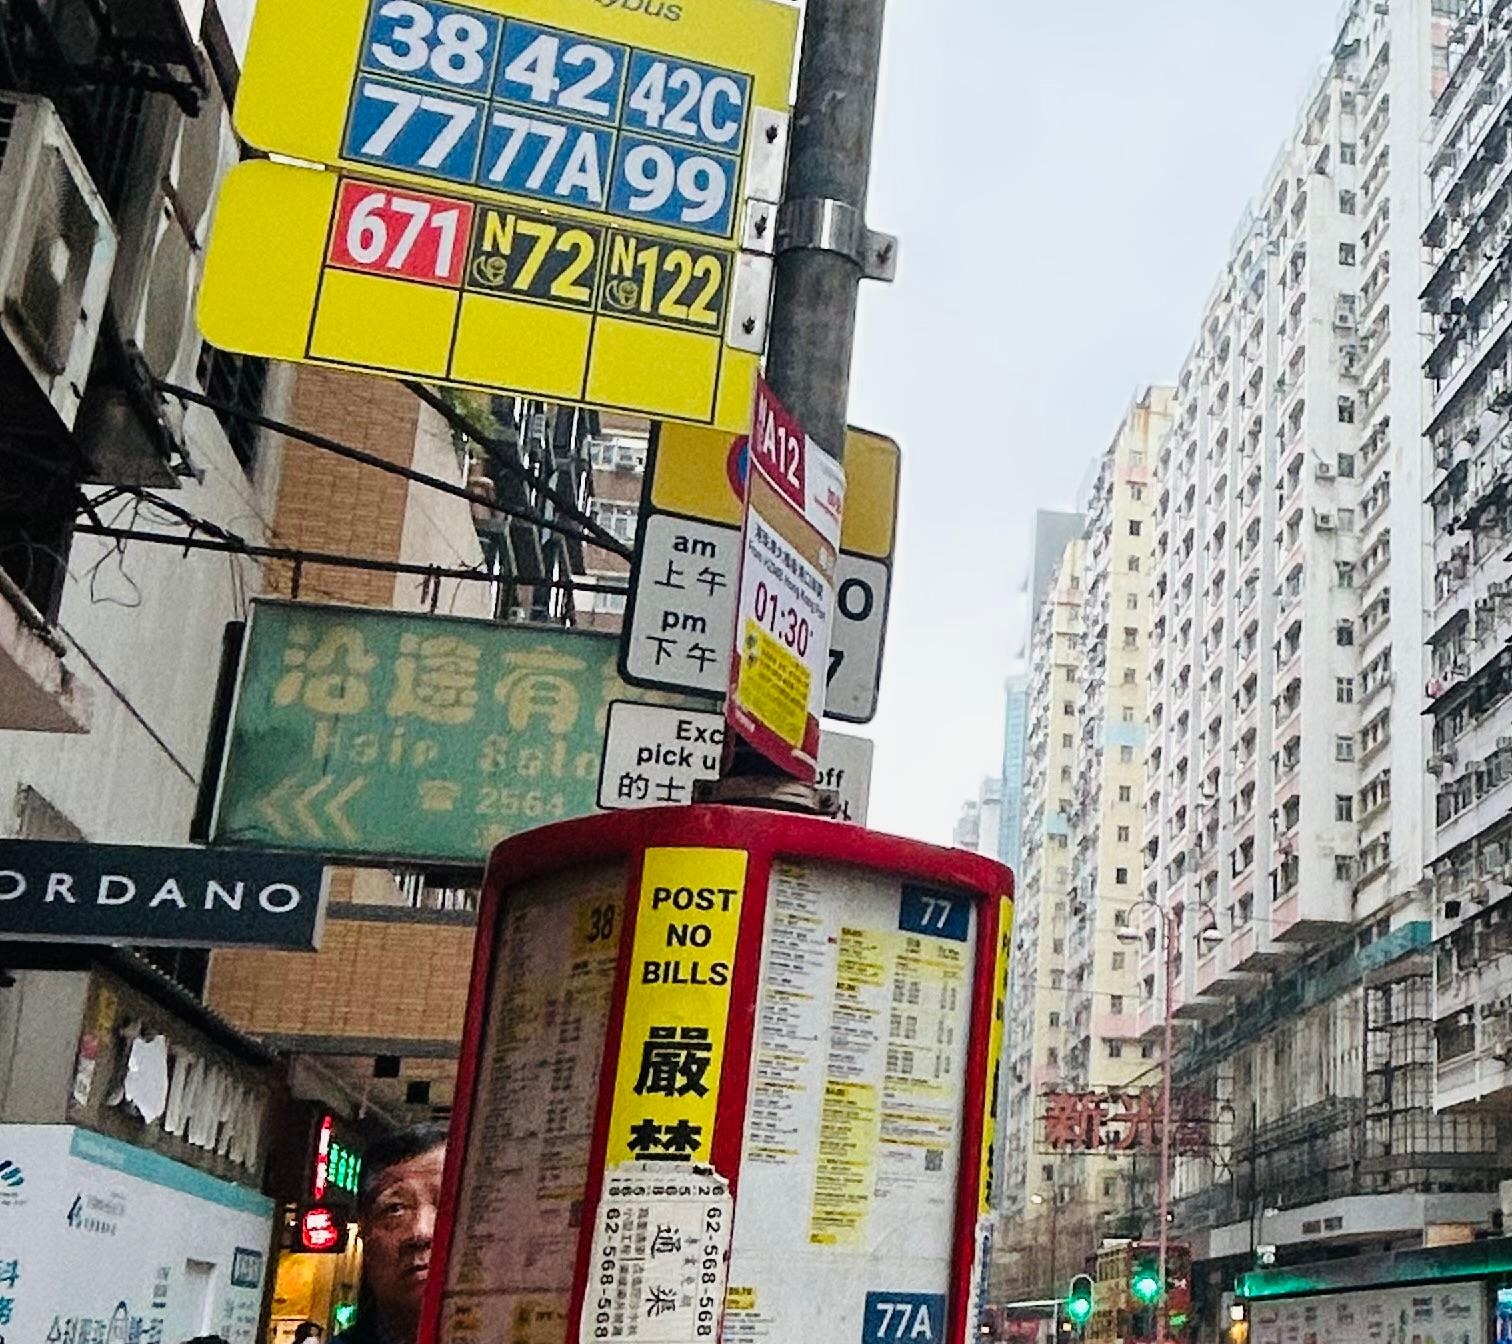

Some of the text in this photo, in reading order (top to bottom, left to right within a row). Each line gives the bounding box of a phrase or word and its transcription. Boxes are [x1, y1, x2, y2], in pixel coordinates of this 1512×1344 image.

[370, 0, 742, 144] 38 42 42C
[360, 83, 727, 223] 77 77A 99
[345, 192, 720, 323] 671 N72 N122
[673, 535, 717, 557] am
[654, 568, 727, 596] 上午
[662, 609, 707, 634] pm
[645, 636, 718, 673] 下午
[637, 744, 693, 769] pick
[618, 771, 686, 805] 的士
[652, 887, 738, 912] POST
[920, 896, 952, 930] 77
[665, 923, 712, 949] NO
[641, 960, 730, 987] BILLS
[594, 1207, 622, 1339] 62-568-568
[696, 1206, 723, 1337] 62-568-568
[875, 1302, 934, 1341] 77A
